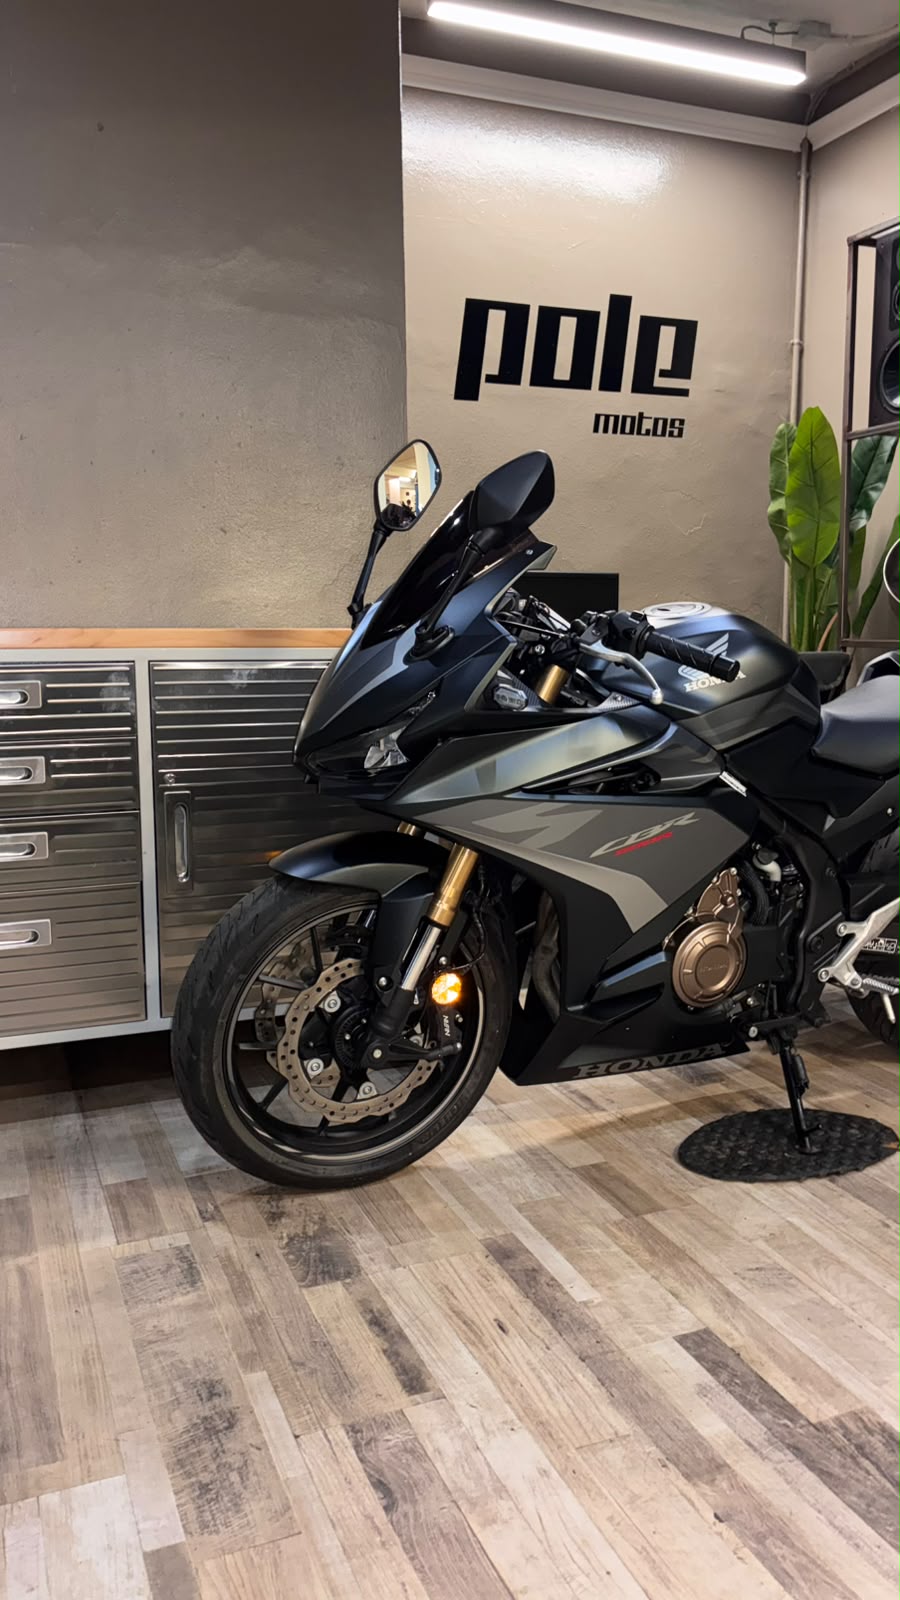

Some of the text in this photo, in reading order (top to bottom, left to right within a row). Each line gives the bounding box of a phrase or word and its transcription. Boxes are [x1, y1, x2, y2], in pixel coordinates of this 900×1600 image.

[454, 294, 698, 401] pole
[593, 411, 685, 438] motos
[683, 669, 746, 692] HONA
[589, 811, 700, 858] CBR
[574, 1043, 725, 1079] HONDA
